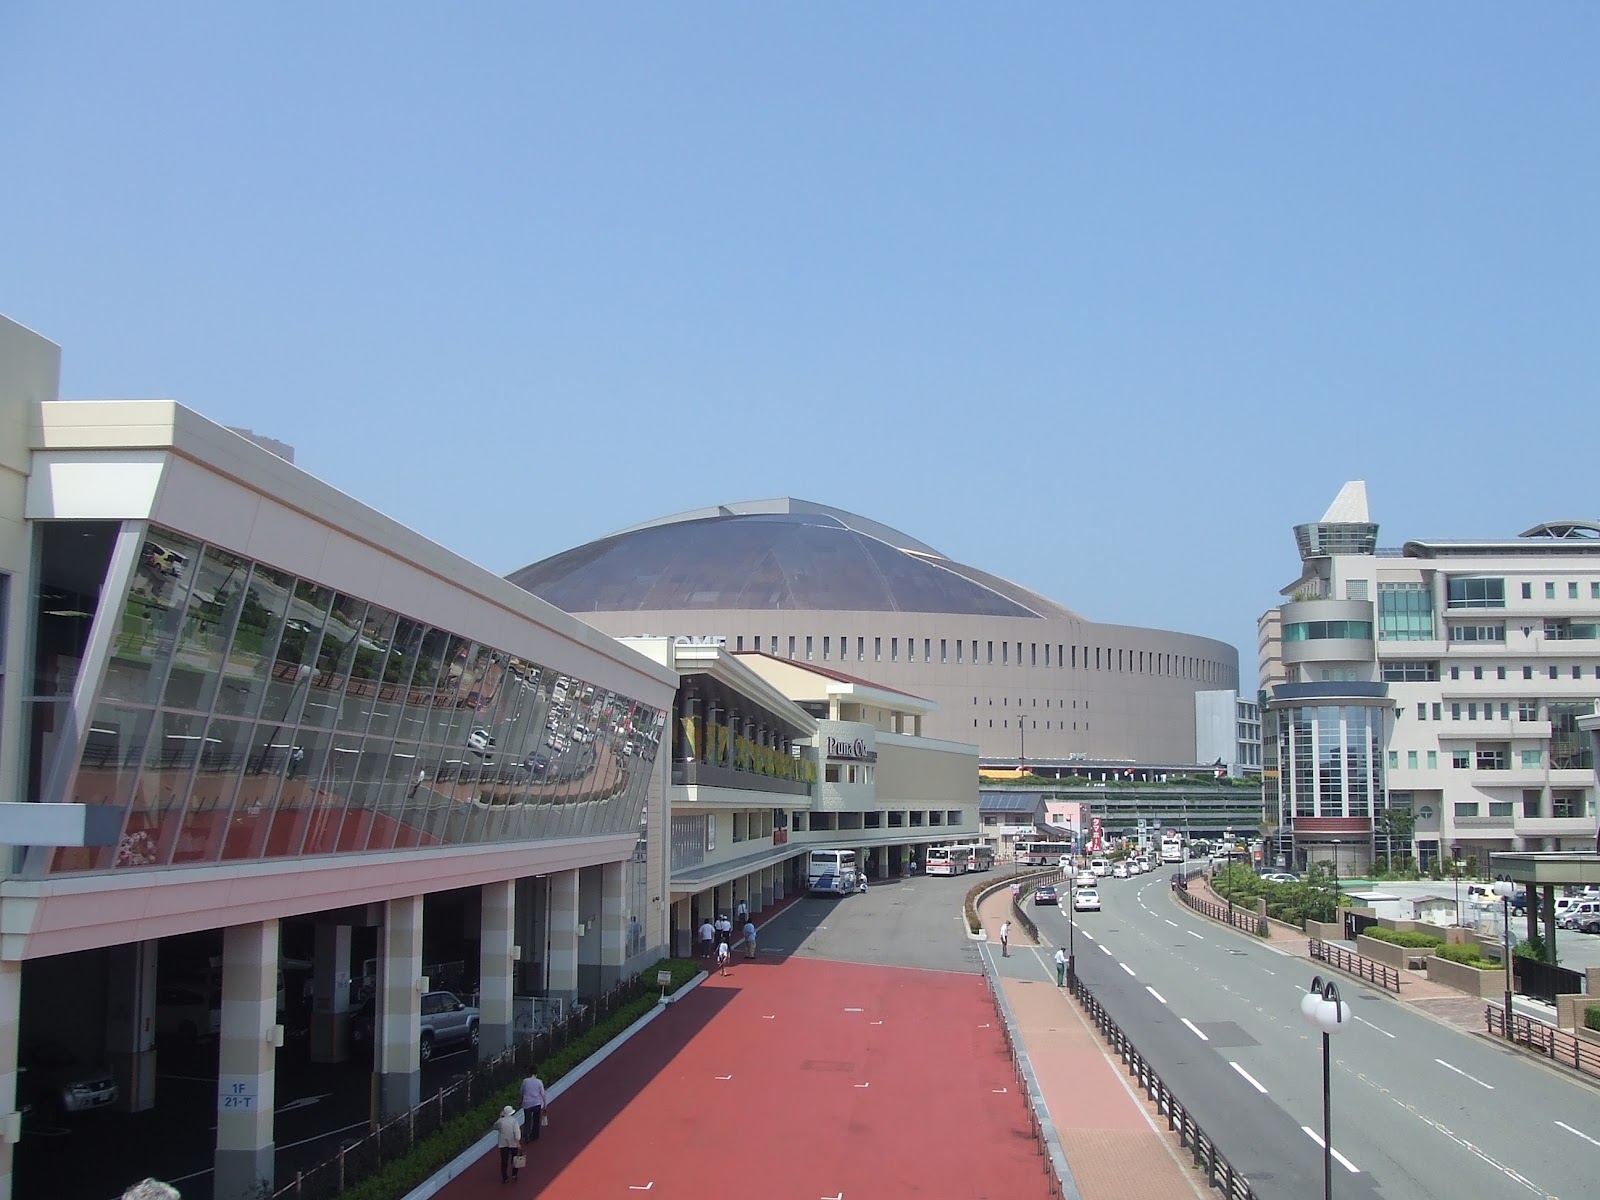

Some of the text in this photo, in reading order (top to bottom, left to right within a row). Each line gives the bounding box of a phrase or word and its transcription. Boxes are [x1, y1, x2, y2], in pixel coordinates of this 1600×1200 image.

[1092, 818, 1101, 851] タマホーム
[232, 1083, 246, 1094] 1F
[224, 1096, 252, 1108] 21-T
